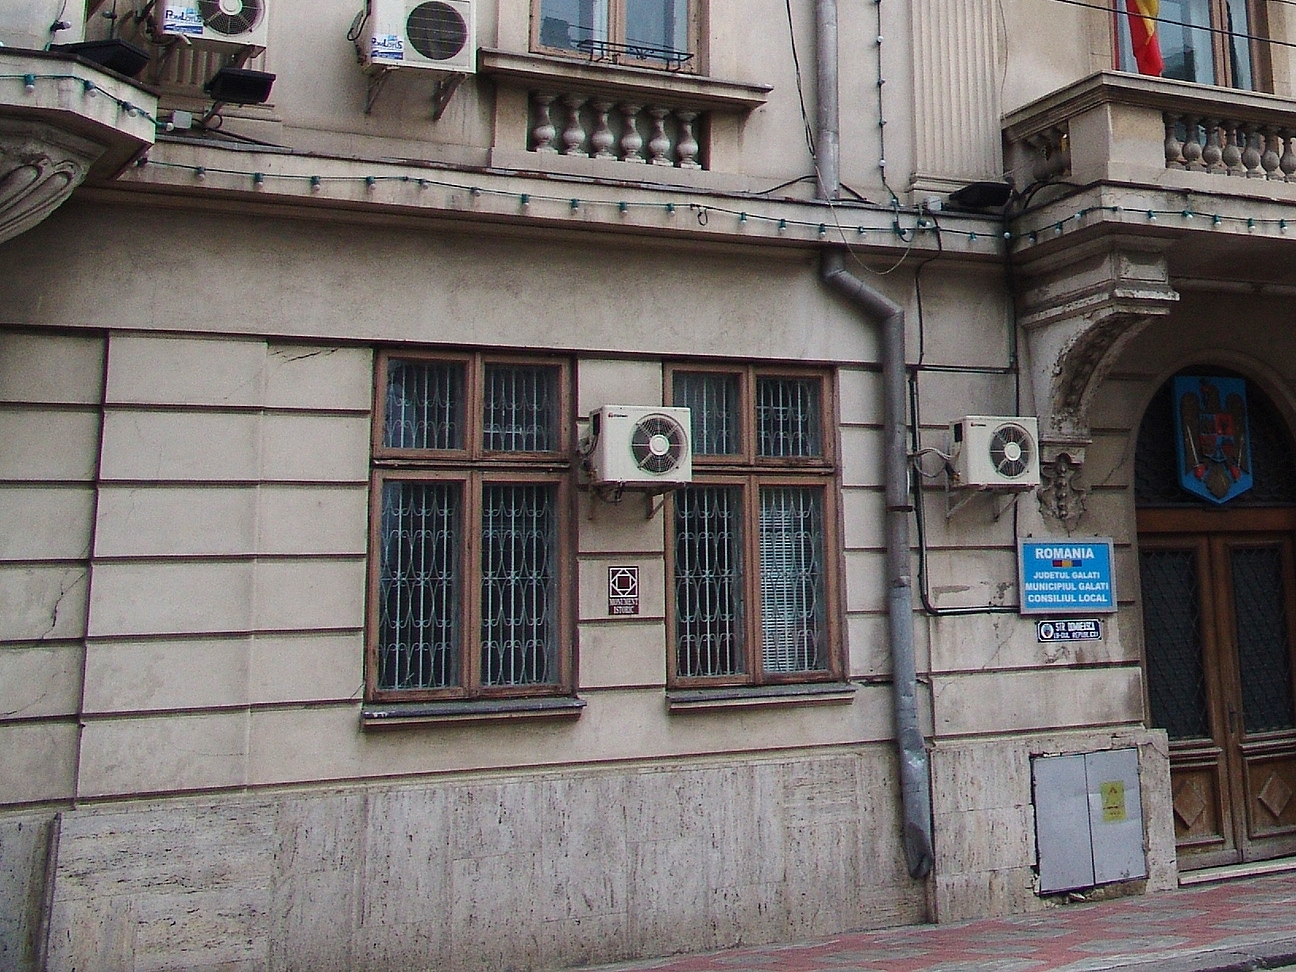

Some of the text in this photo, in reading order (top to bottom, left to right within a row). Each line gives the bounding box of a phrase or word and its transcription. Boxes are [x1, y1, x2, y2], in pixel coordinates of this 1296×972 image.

[1035, 547, 1095, 559] ROMANIA
[1033, 571, 1100, 579] JUDETUL GALATI
[1025, 582, 1109, 590] MUNICIPIUL GALATI
[1028, 594, 1108, 602] CONSILIUL LOCAL
